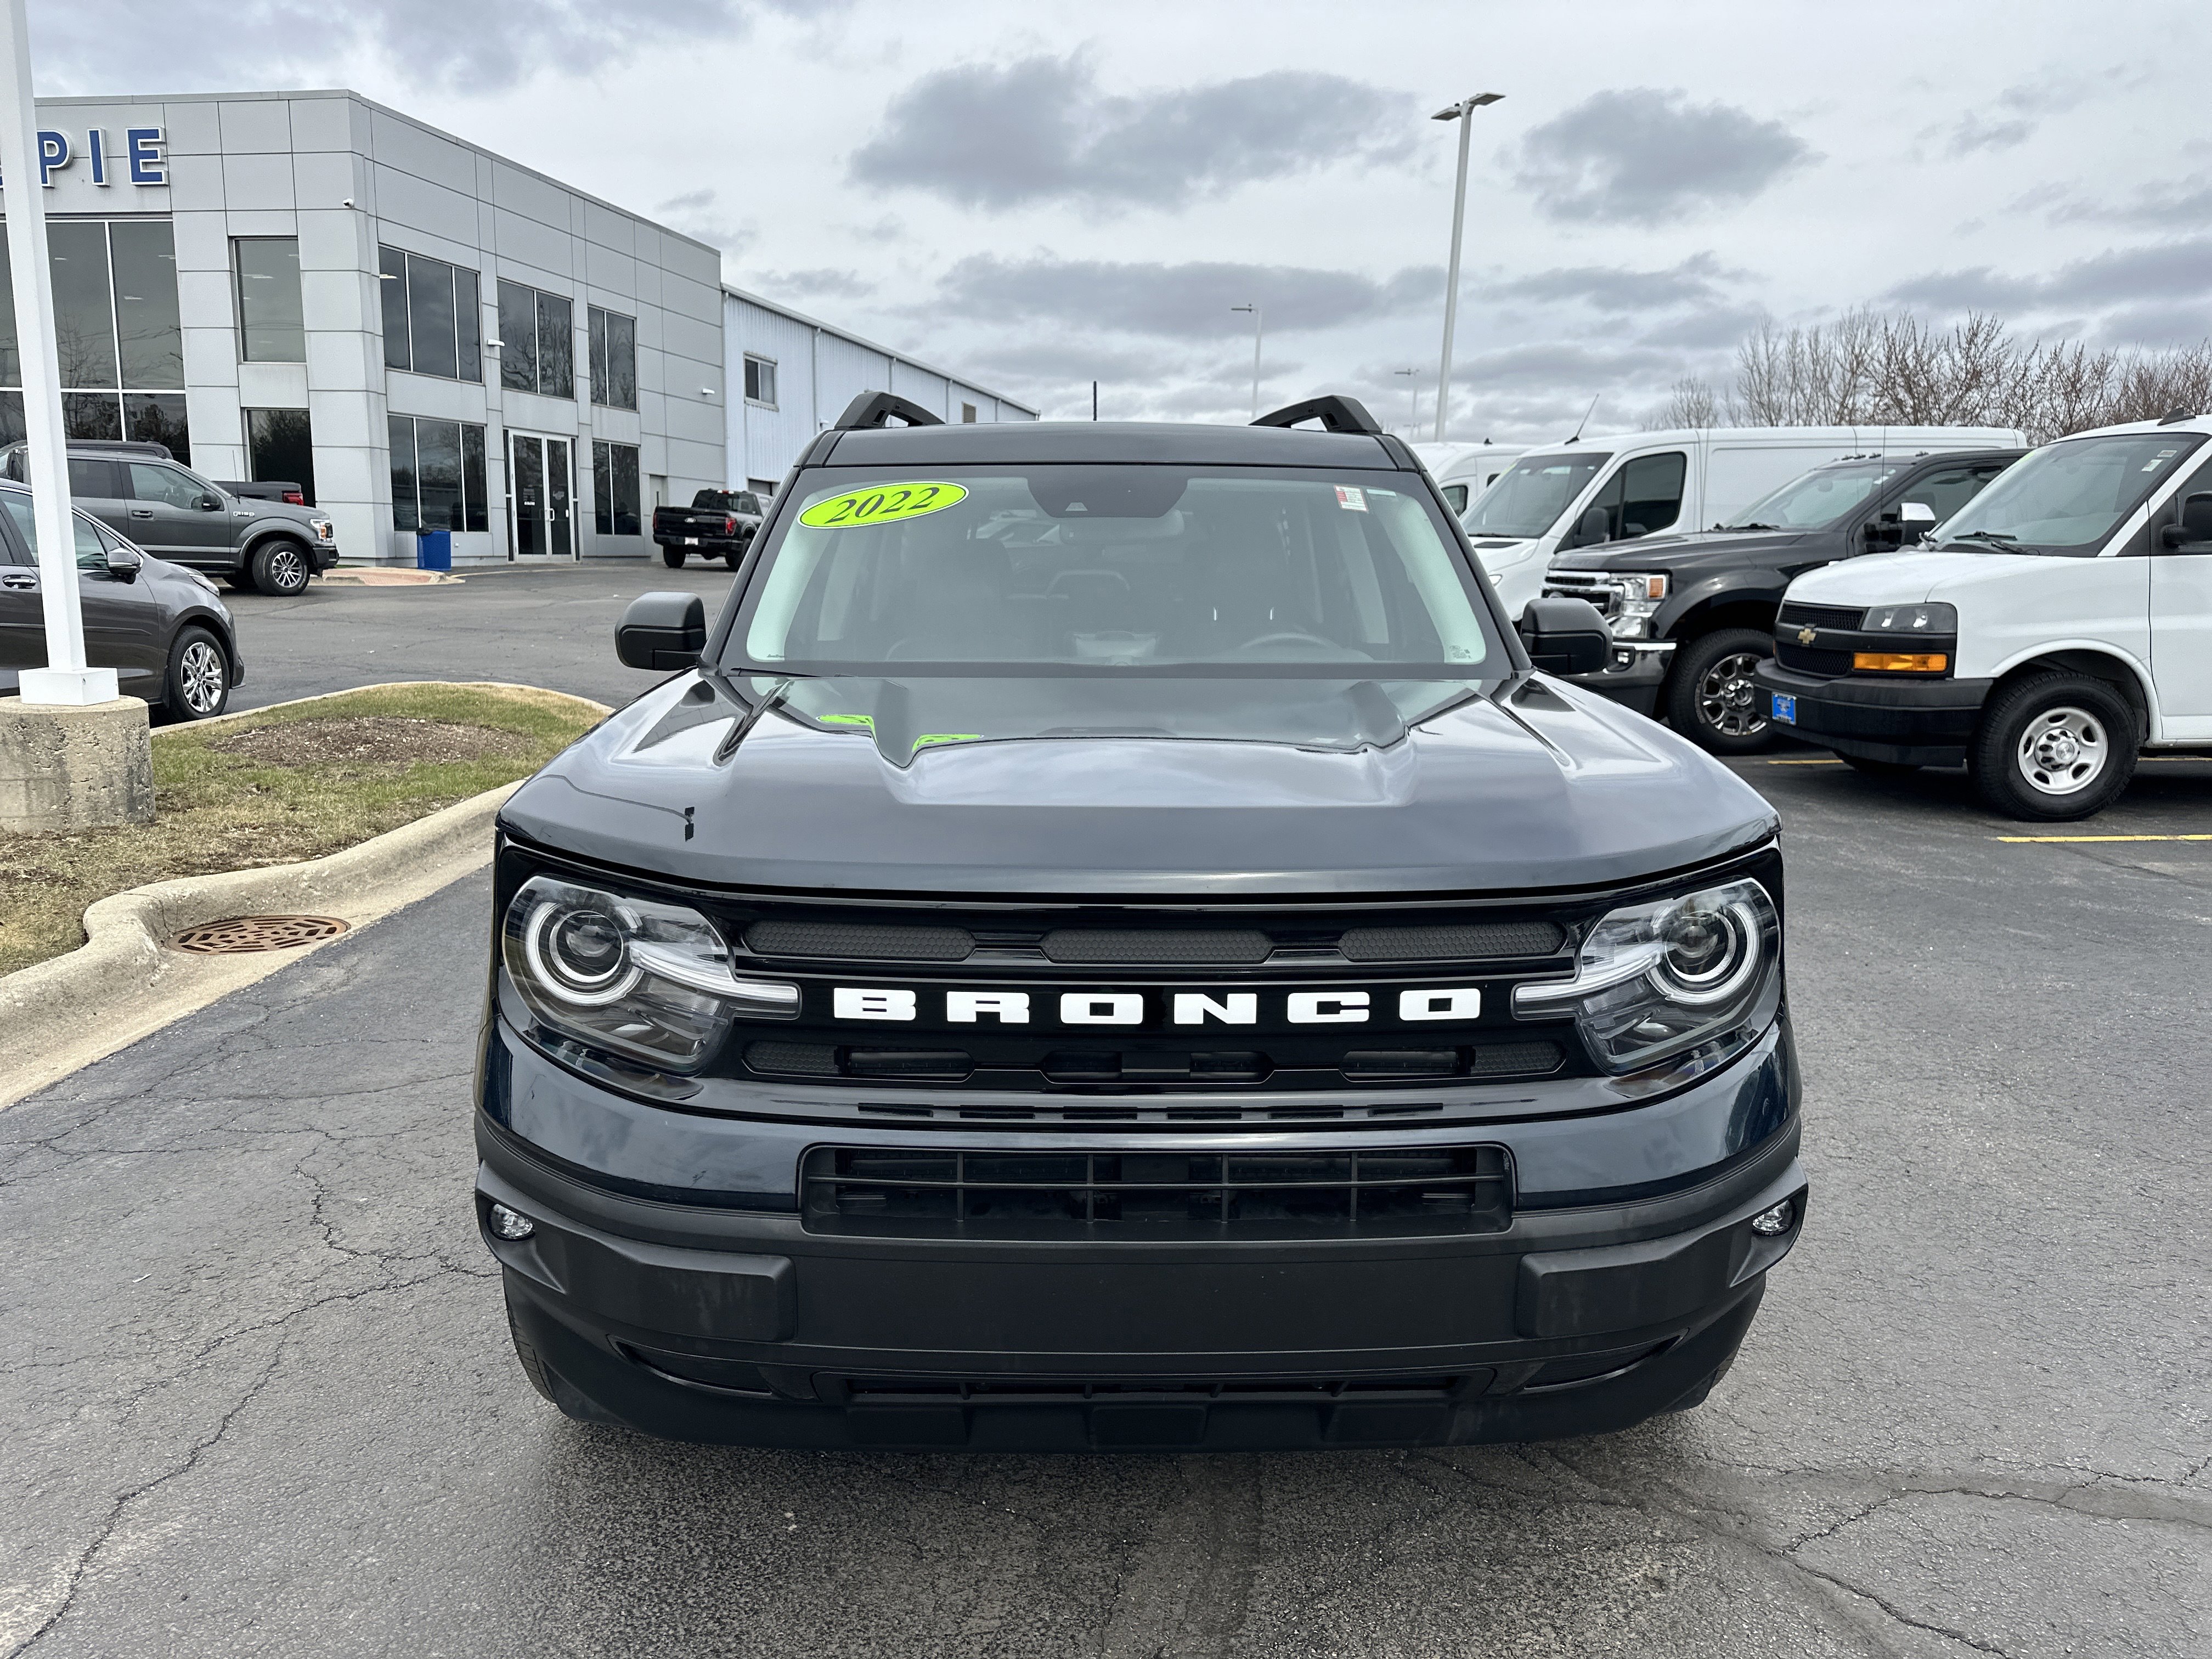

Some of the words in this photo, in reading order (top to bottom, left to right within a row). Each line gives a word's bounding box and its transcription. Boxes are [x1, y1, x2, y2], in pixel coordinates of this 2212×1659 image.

[0, 127, 168, 187] PIE
[823, 487, 940, 524] 2022
[833, 988, 1481, 1024] BRONCO
